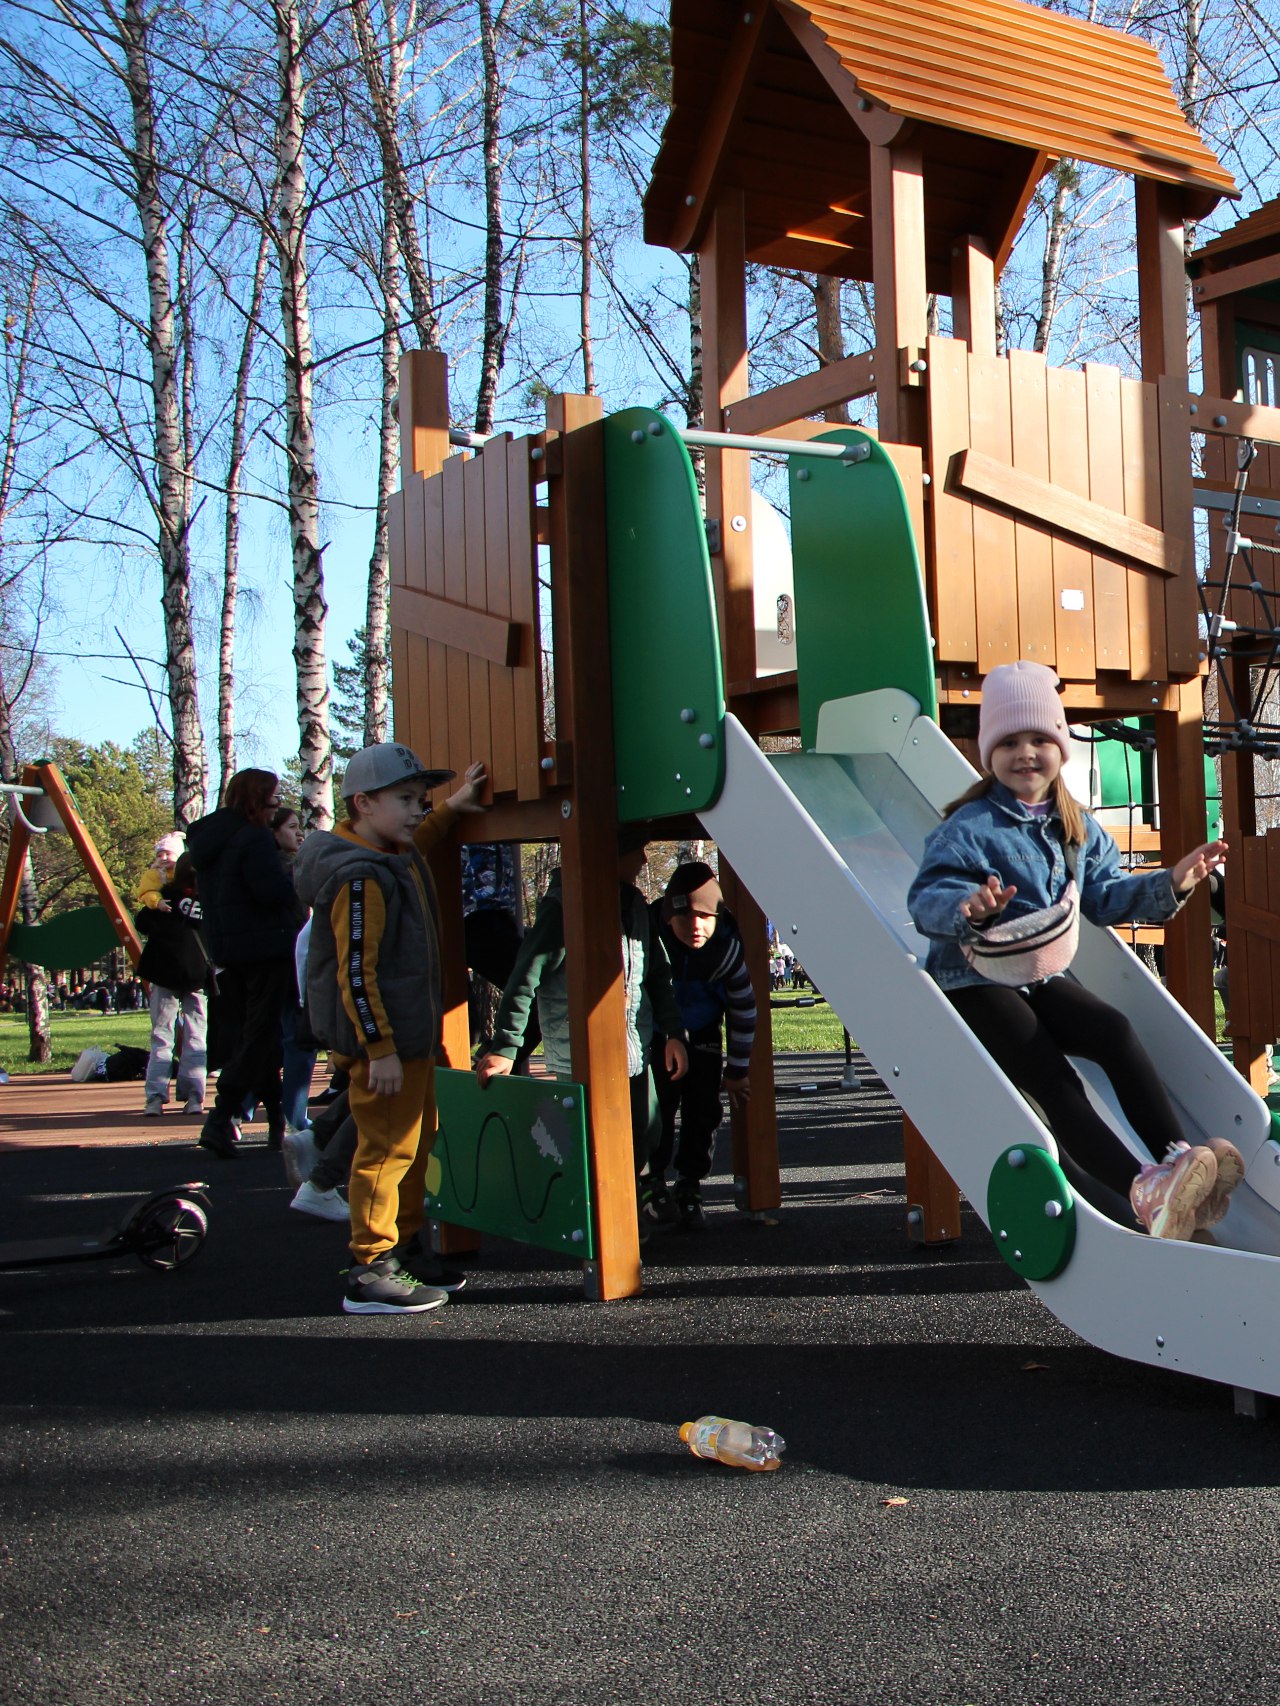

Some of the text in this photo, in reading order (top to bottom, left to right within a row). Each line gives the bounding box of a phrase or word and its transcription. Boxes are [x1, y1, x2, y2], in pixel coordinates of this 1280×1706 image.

[179, 897, 204, 920] GE
[352, 902, 363, 940] MINIDINO
[351, 951, 363, 987] MINIDNO
